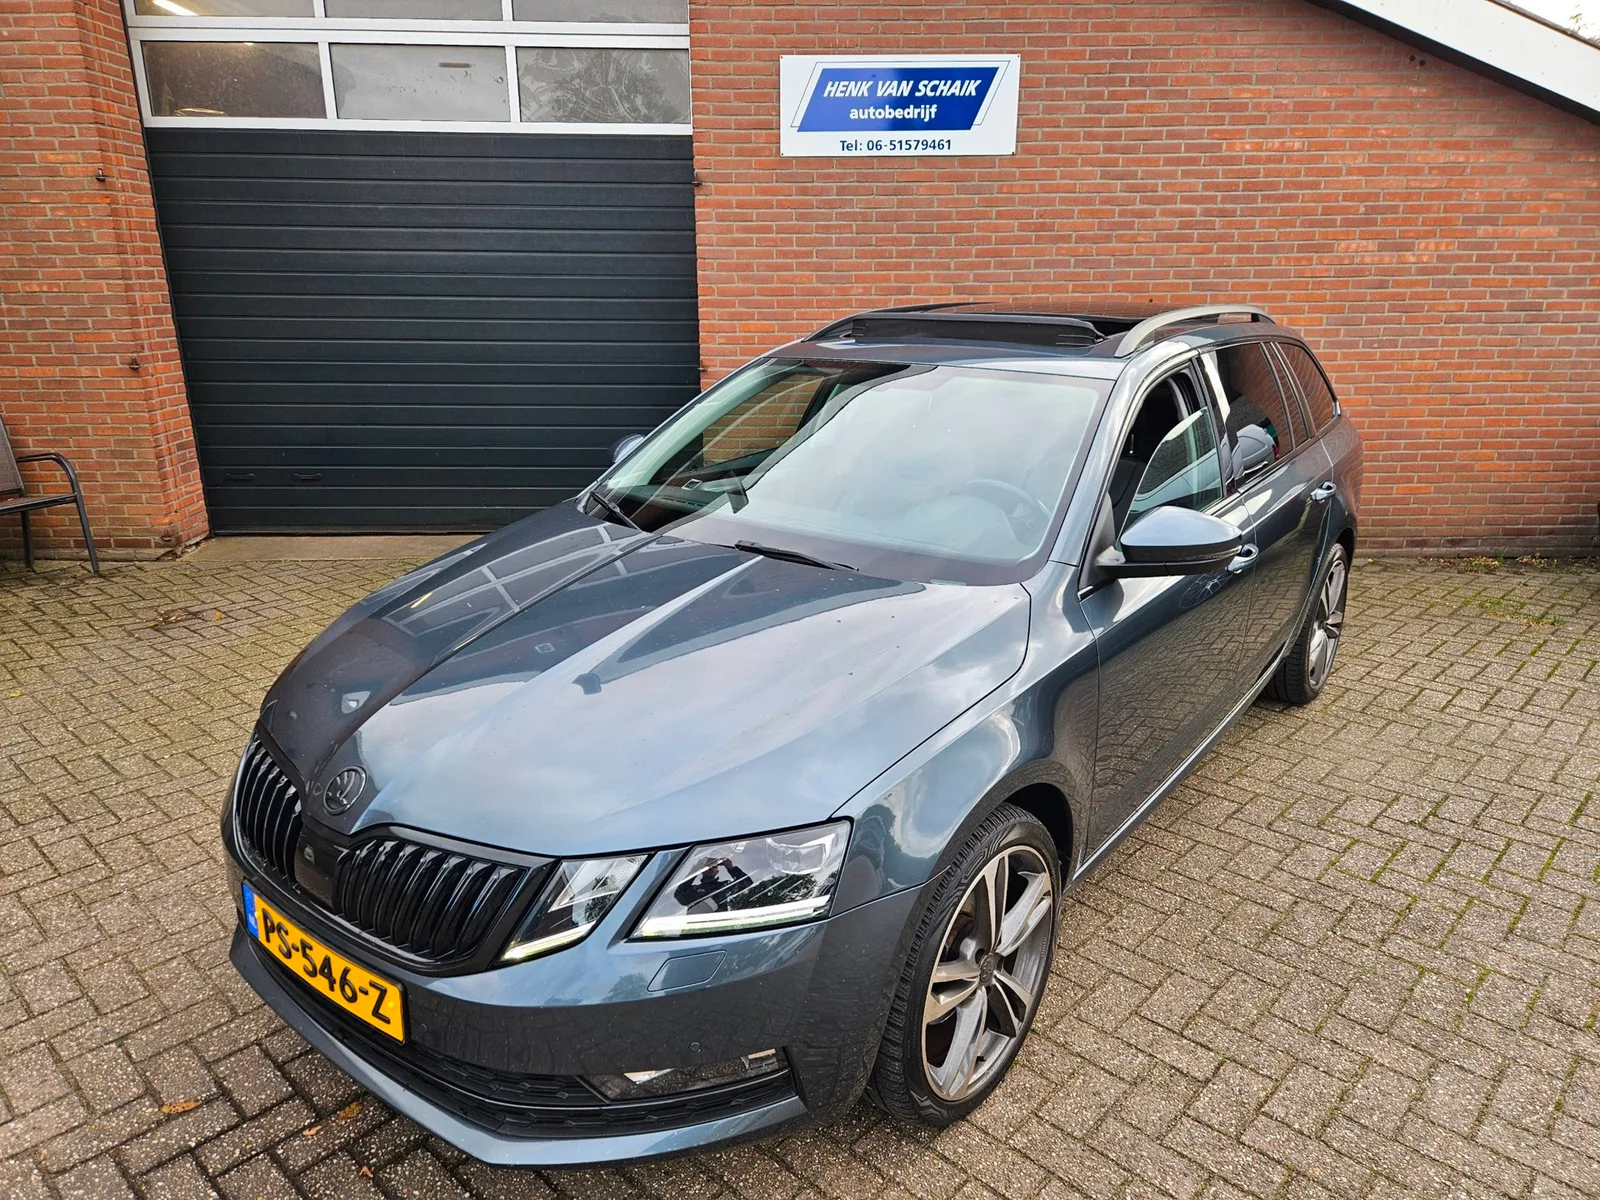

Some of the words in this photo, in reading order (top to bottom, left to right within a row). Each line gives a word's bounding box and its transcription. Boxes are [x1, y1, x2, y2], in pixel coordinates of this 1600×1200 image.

[823, 80, 874, 98] HENK
[876, 80, 914, 97] VAN
[915, 79, 982, 97] SCHAIK
[849, 104, 938, 122] autobedrijf
[839, 139, 863, 151] Tel:
[866, 139, 952, 151] 06-51579461
[261, 907, 392, 1025] PS-546-Z
